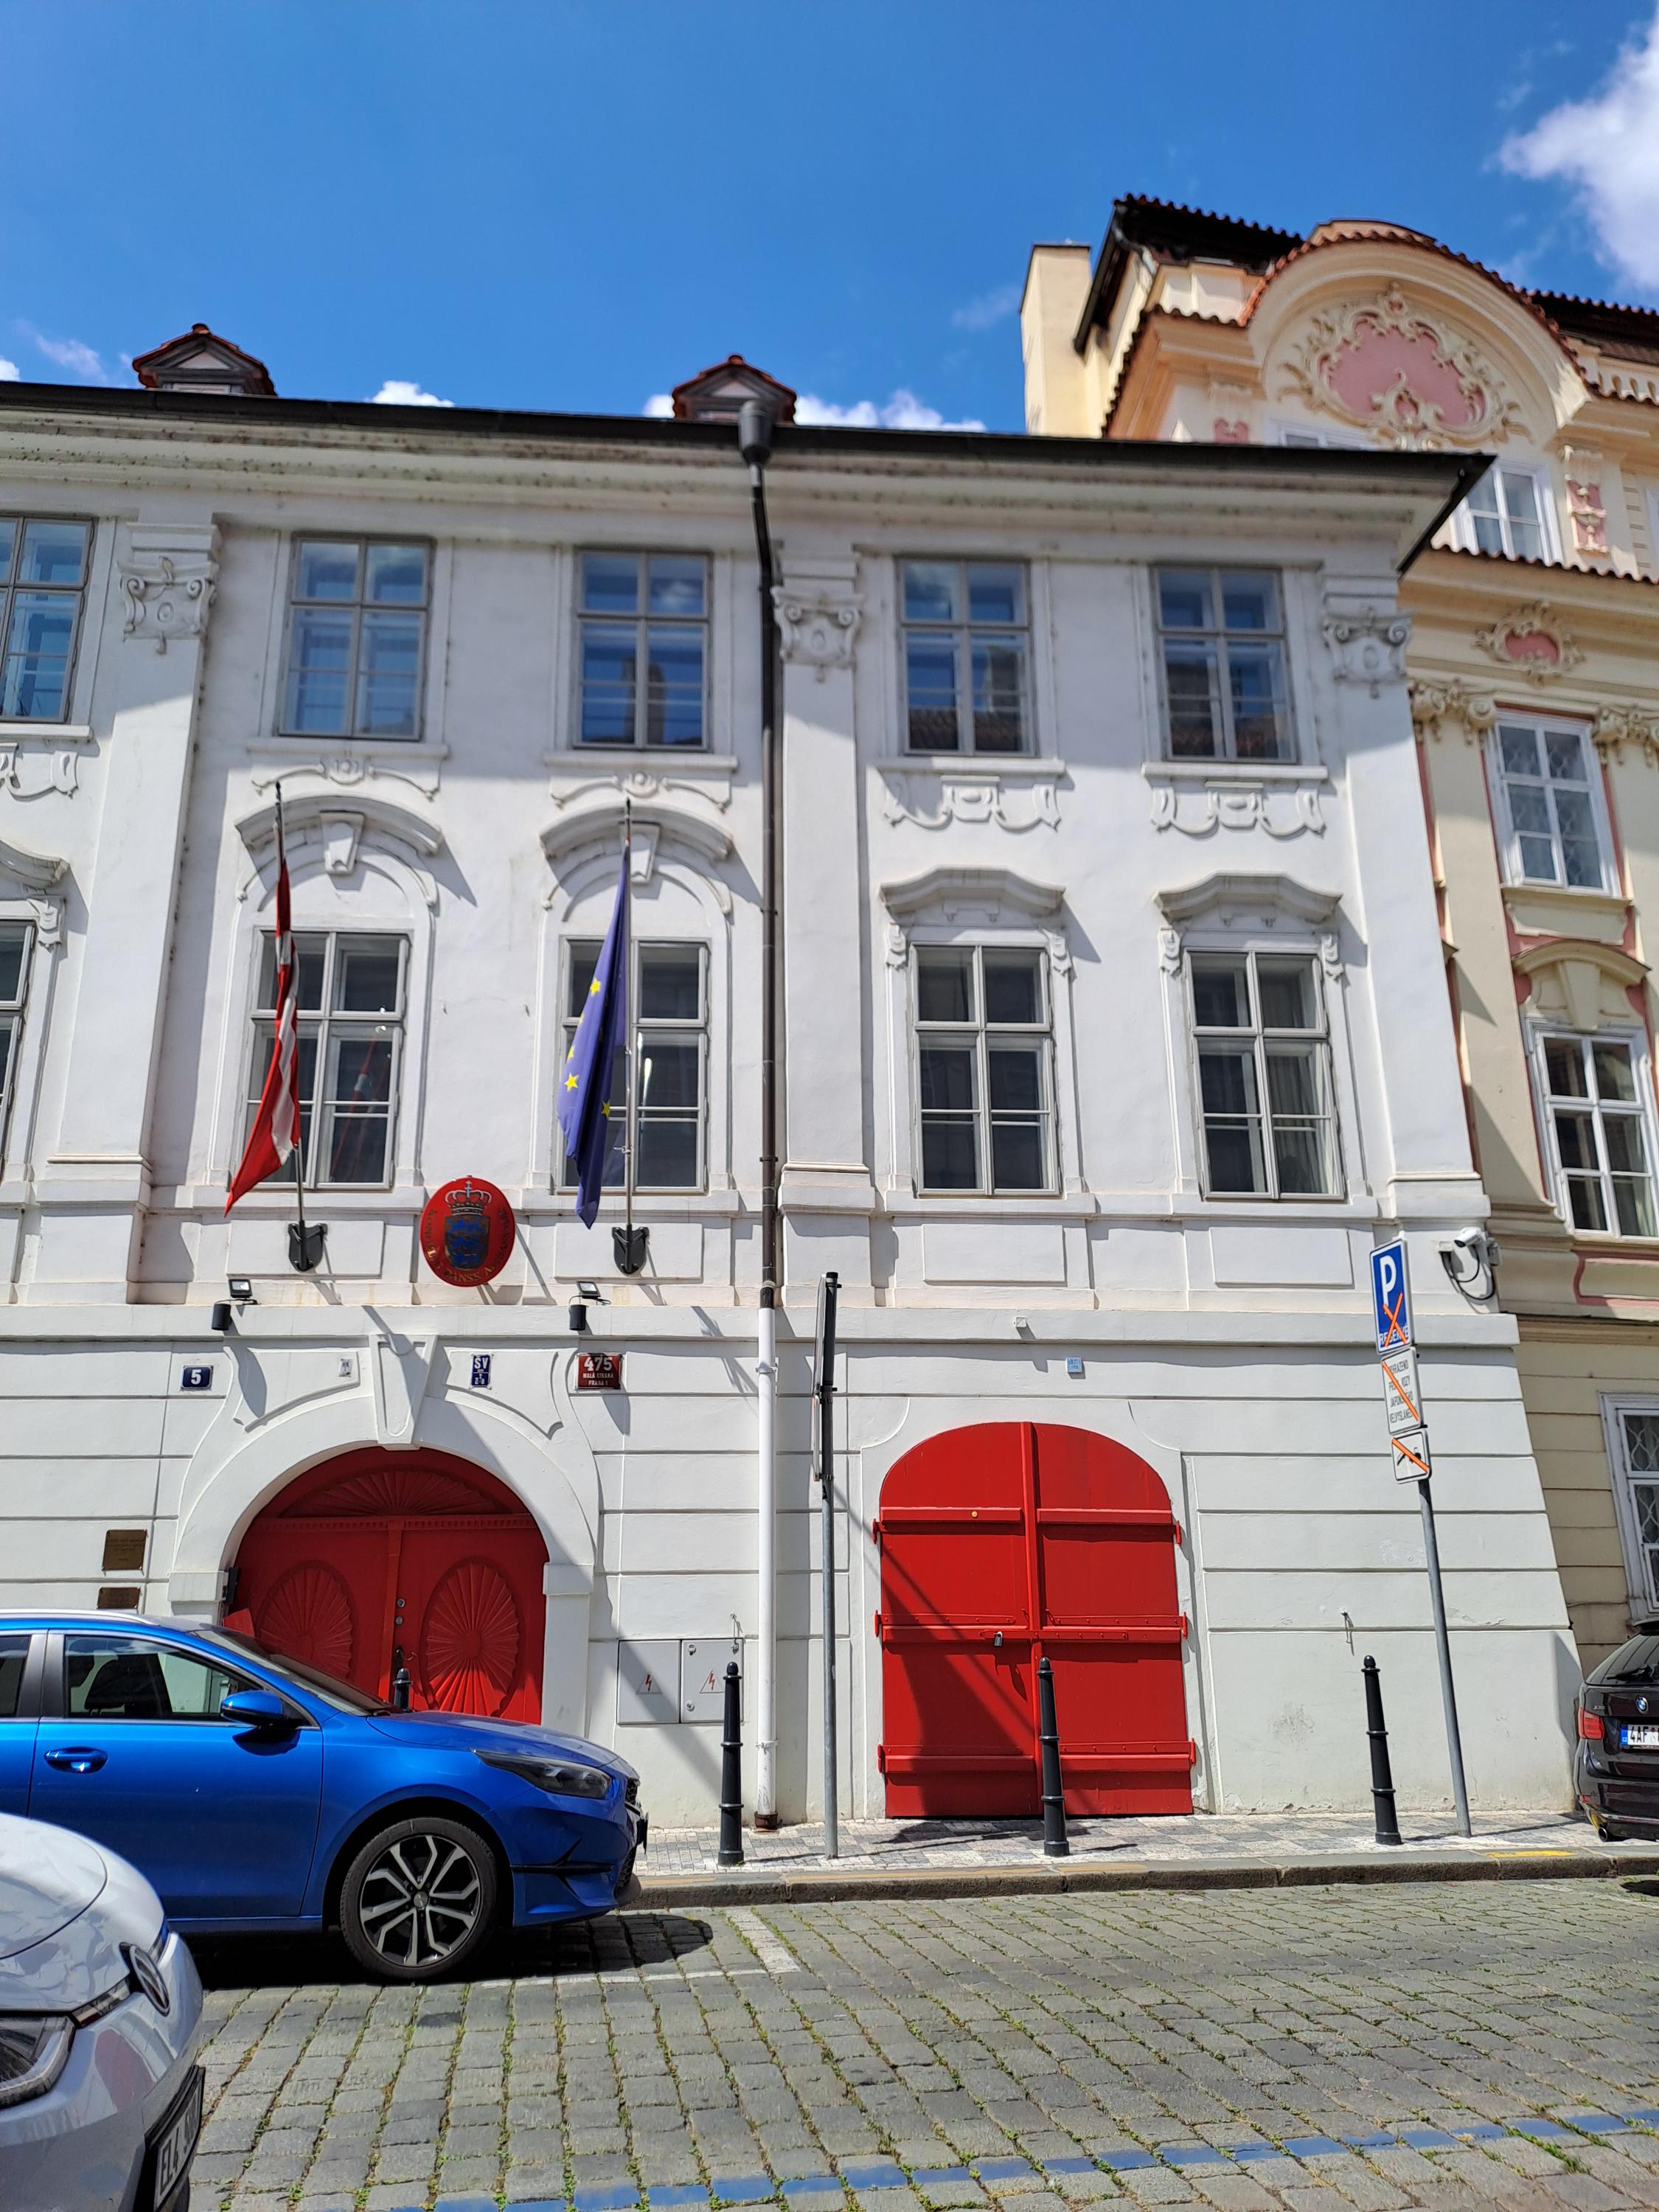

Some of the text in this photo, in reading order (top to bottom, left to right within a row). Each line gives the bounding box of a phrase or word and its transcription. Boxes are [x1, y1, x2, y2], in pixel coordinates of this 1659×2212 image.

[1380, 1255, 1397, 1315] P
[584, 1356, 613, 1371] 475
[191, 1368, 202, 1385] 5
[1630, 1726, 1648, 1743] 4AF
